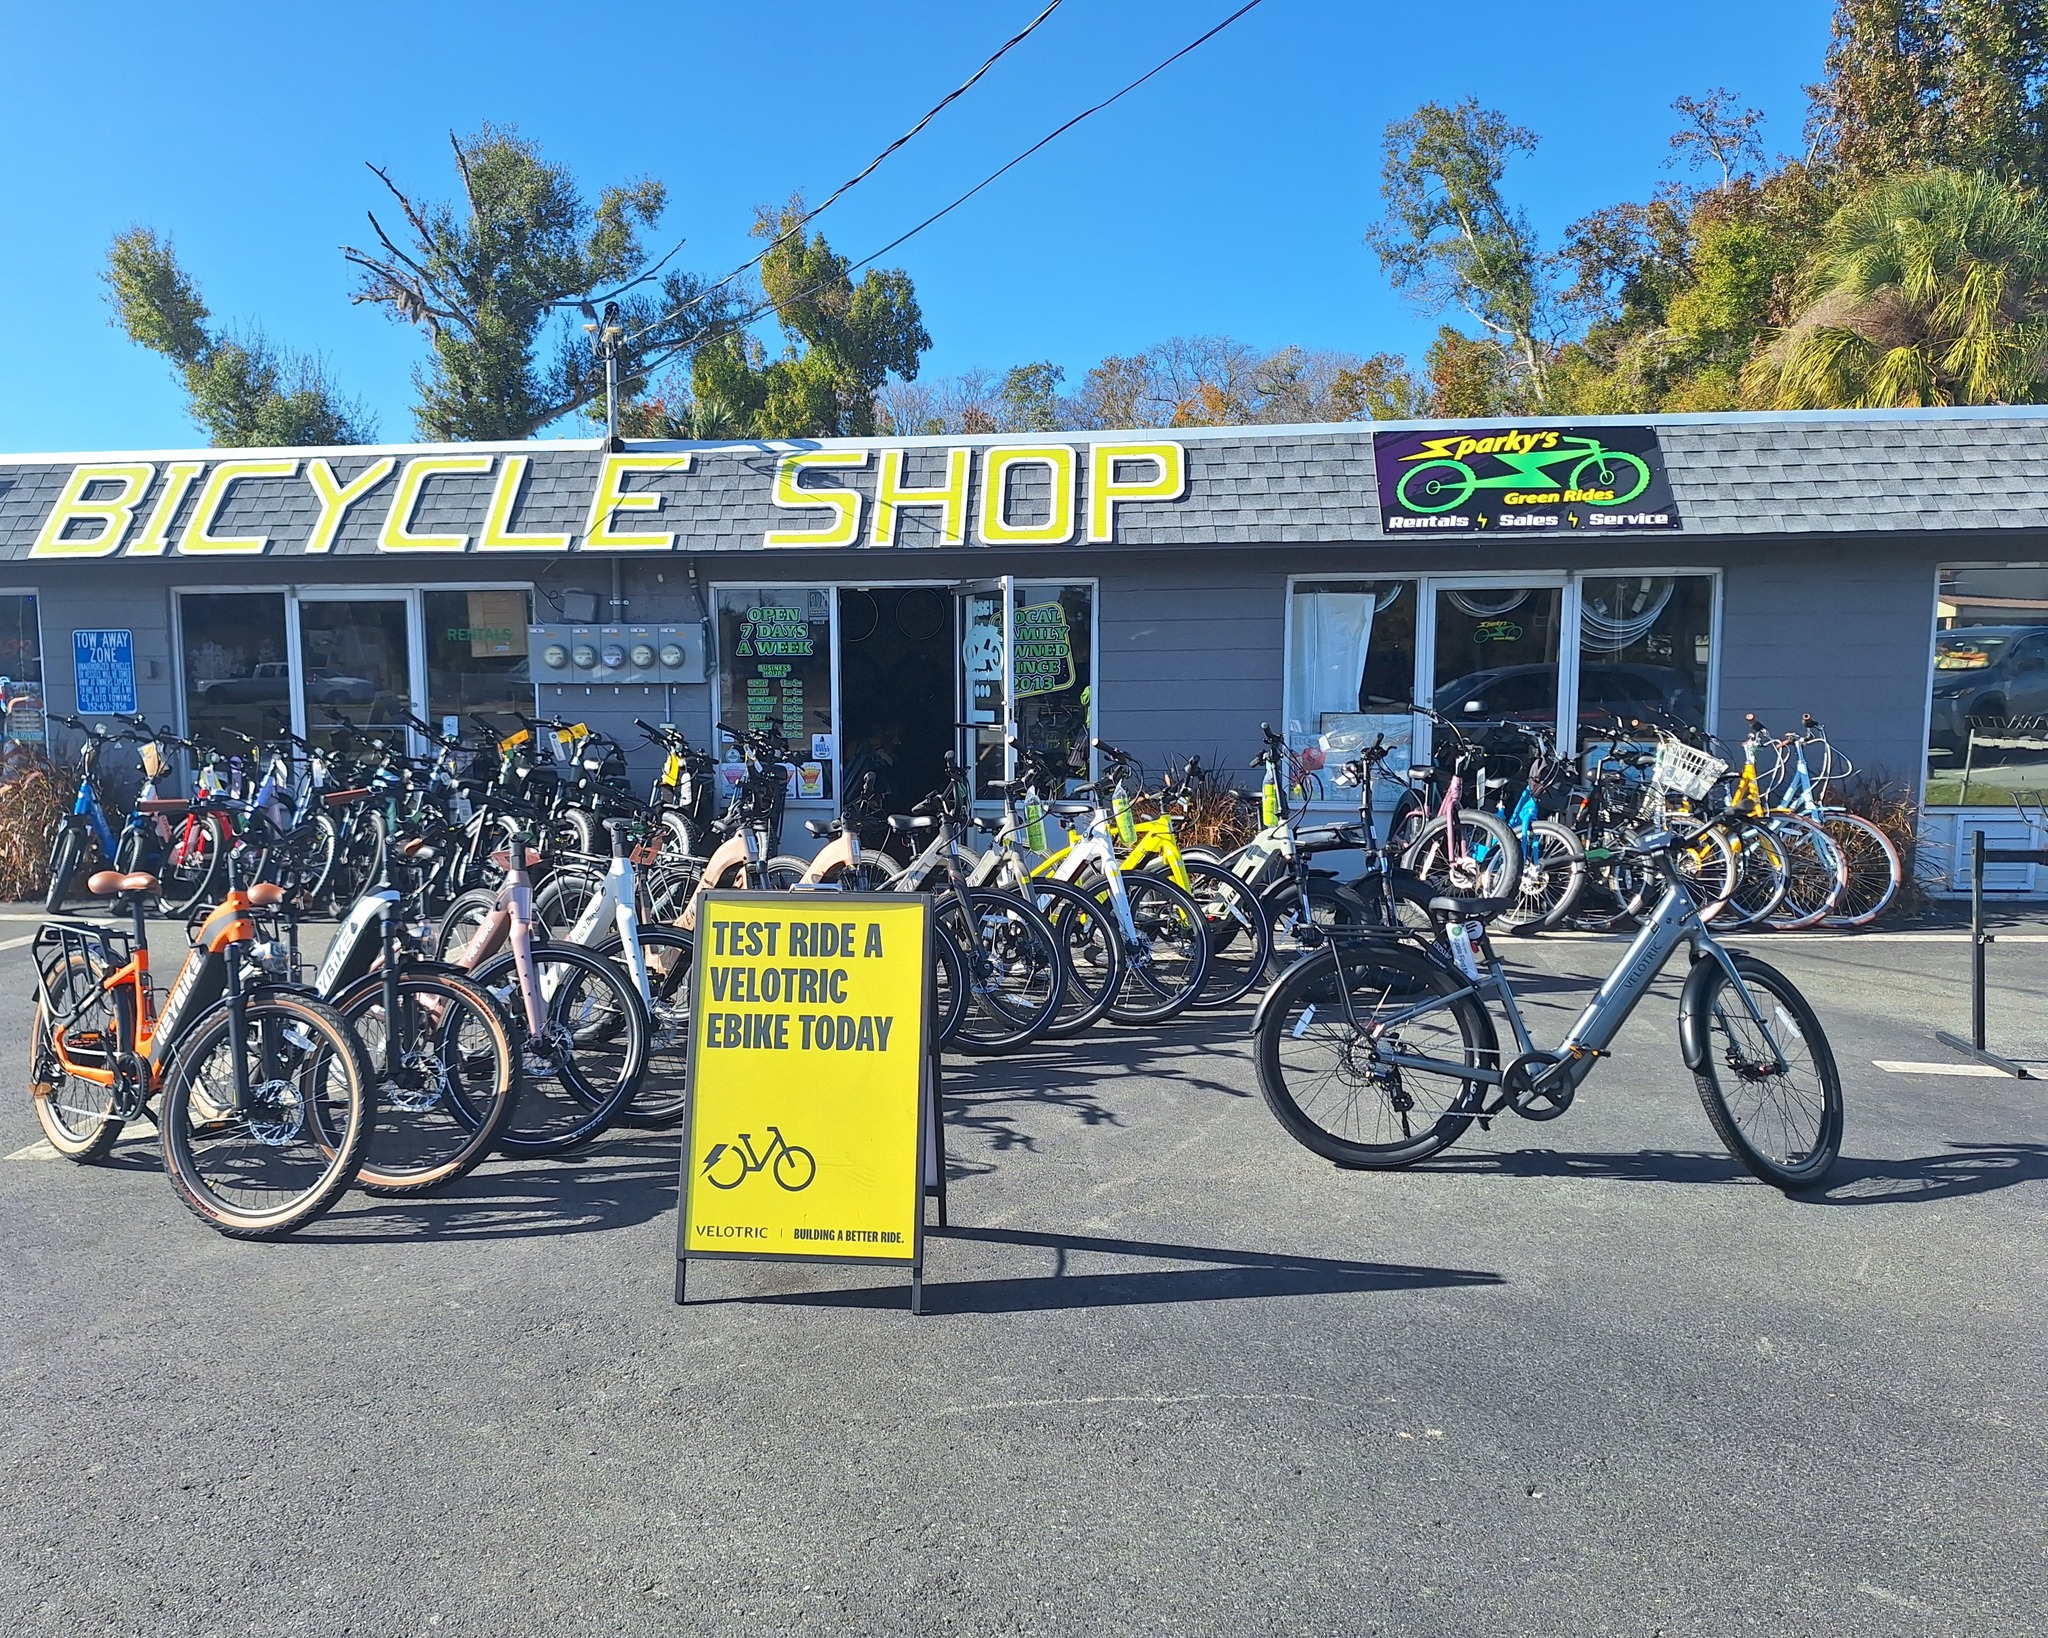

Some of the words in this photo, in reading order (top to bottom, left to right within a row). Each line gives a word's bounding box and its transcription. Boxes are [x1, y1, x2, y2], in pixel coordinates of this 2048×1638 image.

[1397, 430, 1559, 461] Sparky's
[28, 453, 692, 558] BICYCLE
[763, 441, 1186, 549] SHOP
[1503, 490, 1560, 506] Green
[1563, 488, 1614, 503] Rides
[1389, 514, 1470, 529] Rentals
[1499, 513, 1559, 527] Sales
[1589, 512, 1669, 526] Service
[747, 607, 800, 623] OPEN
[1013, 609, 1062, 624] OCAL
[447, 627, 513, 641] RENTALS
[741, 624, 753, 639] 7
[757, 624, 808, 639] DAYS
[75, 632, 97, 649] TOW
[102, 632, 128, 648] AWAY
[736, 640, 753, 656] A
[755, 640, 813, 655] WEEK
[90, 647, 118, 663] ZONE
[1014, 643, 1069, 657] WNED
[1014, 661, 1059, 675] INCE
[712, 921, 781, 957] TEST
[789, 922, 856, 958] RIDE
[864, 923, 883, 958] A
[318, 931, 354, 990] YBIKE
[1624, 941, 1662, 989] VELOTRIC
[710, 967, 849, 1004] VELOTRIC
[155, 951, 203, 1047] HEYBIKE
[707, 1013, 790, 1050] EBIKE
[798, 1014, 894, 1052] TODAY
[696, 1225, 768, 1240] VELOTRIC
[794, 1228, 835, 1242] BUILDING
[837, 1230, 844, 1242] A
[845, 1230, 878, 1243] BETTER
[880, 1231, 905, 1244] RIDE.
